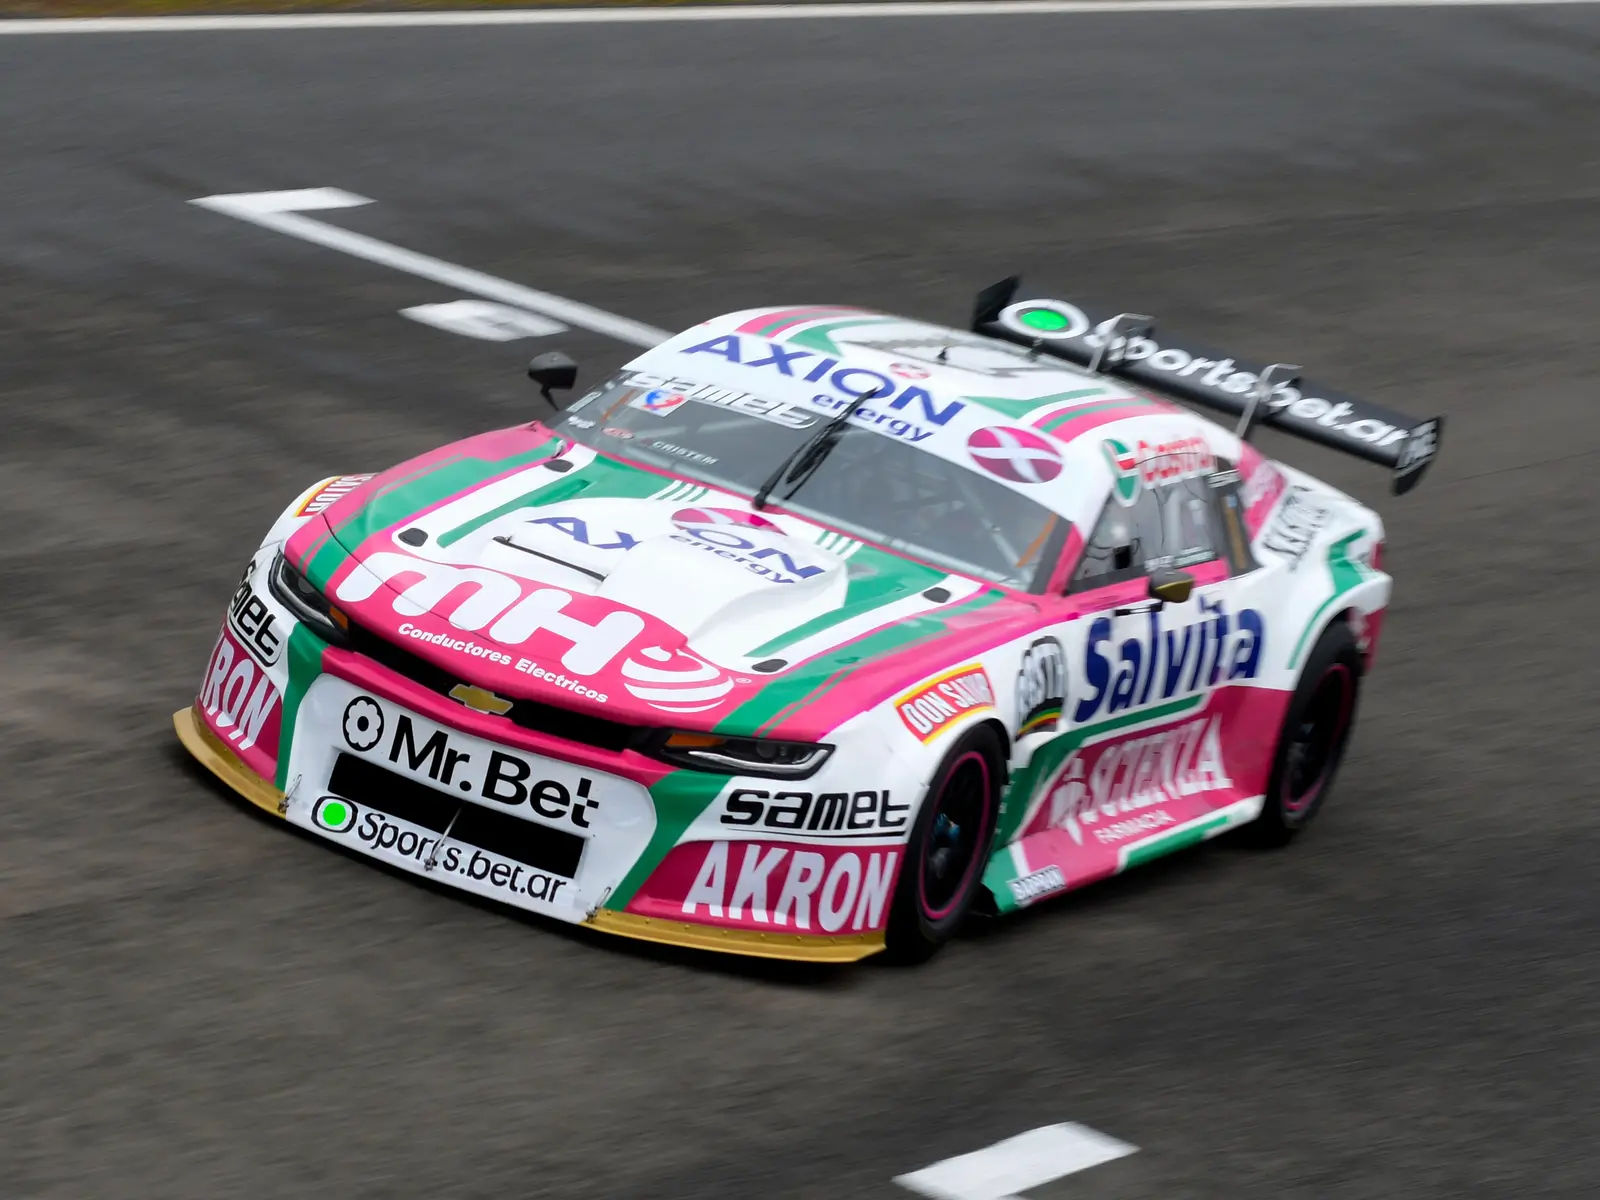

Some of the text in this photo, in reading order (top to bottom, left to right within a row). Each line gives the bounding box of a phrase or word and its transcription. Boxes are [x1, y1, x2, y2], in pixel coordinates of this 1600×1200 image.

[679, 334, 966, 426] AXION
[811, 393, 935, 442] energy
[524, 516, 826, 579] AXON
[669, 534, 796, 584] energy
[201, 635, 281, 751] RON
[398, 622, 609, 703] Conductores Electricos
[1073, 594, 1264, 723] Salvita
[901, 691, 958, 734] DON
[389, 714, 600, 829] Mr. Bet
[720, 788, 911, 831] samet
[681, 841, 898, 932] AKRON
